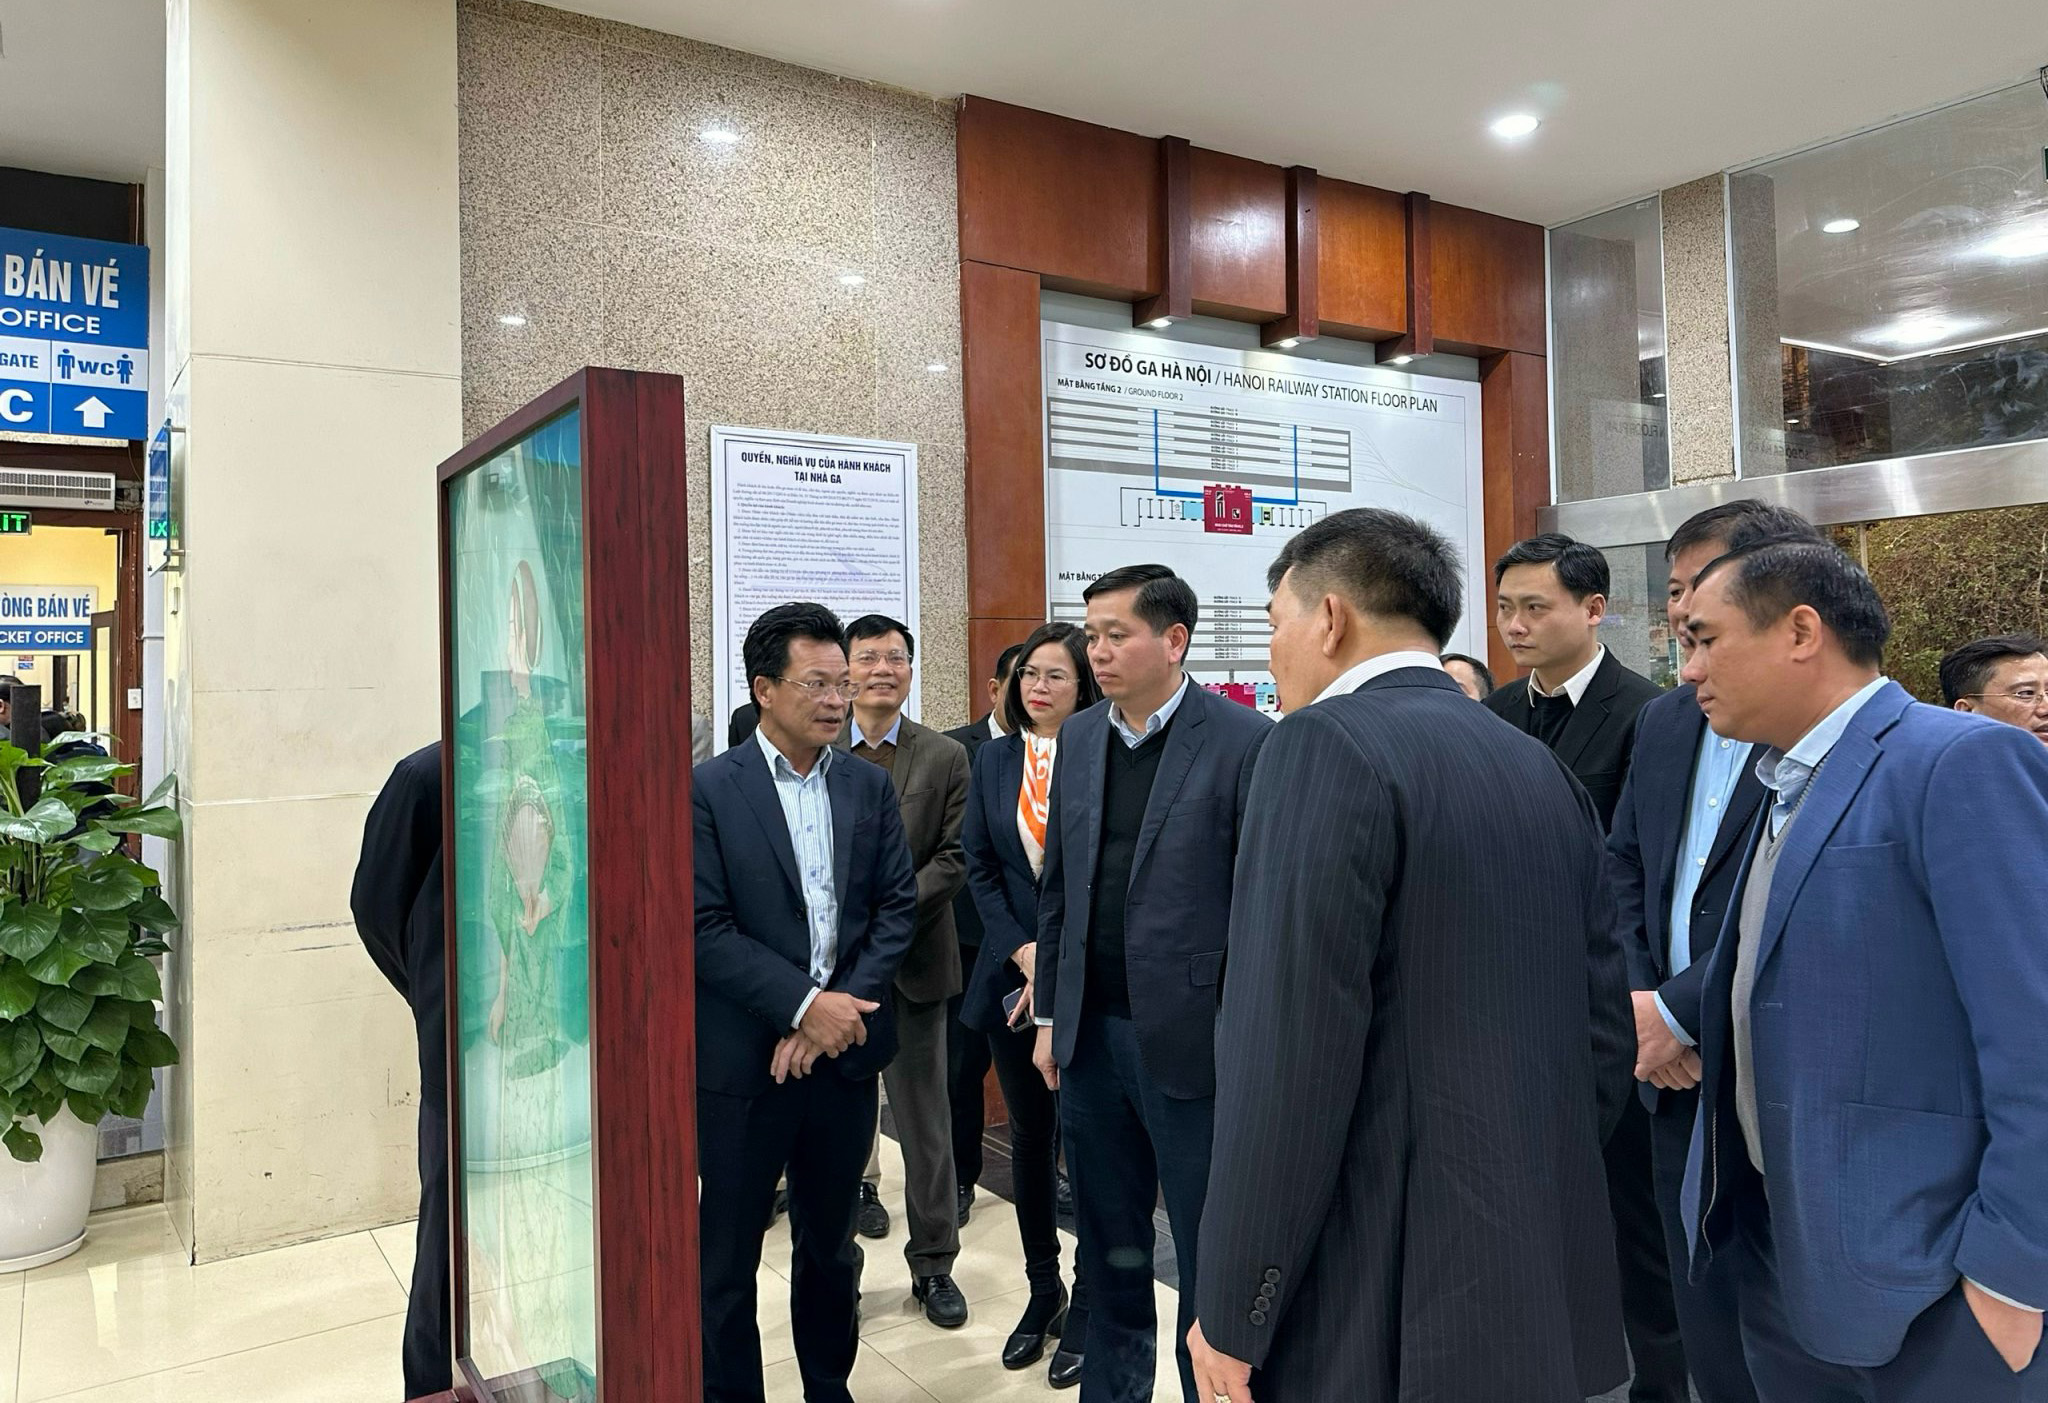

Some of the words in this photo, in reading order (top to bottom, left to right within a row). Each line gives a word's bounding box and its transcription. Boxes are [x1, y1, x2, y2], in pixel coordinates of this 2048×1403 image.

[4, 248, 72, 304] BÁN
[82, 258, 120, 309] VÉ
[0, 307, 101, 335] OFFICE
[0, 353, 39, 369] GATE
[78, 360, 115, 376] WC
[1085, 353, 1107, 370] SƠ
[1109, 354, 1133, 374] ĐỒ
[1137, 360, 1158, 377] GA
[1162, 361, 1182, 380] HÀ
[1186, 365, 1212, 387] NỘI
[1224, 370, 1265, 391] HANOI
[1268, 380, 1319, 398] RAILWAY
[1321, 385, 1368, 404] STATION
[1371, 391, 1408, 410] FLOOR
[1409, 396, 1438, 413] PLAN
[1117, 386, 1122, 394] 2
[1128, 387, 1157, 398] GROUND
[1158, 390, 1179, 401] FLOOR
[1179, 393, 1184, 401] 2
[0, 388, 34, 423] C
[776, 454, 803, 467] NGHĨA
[805, 457, 816, 470] VỤ
[818, 456, 836, 469] CỦA
[838, 458, 861, 471] HÀNH
[863, 460, 891, 473] KHÁCH
[794, 471, 808, 484] TẠI
[810, 471, 828, 483] NHÀ
[830, 474, 842, 484] GA
[1, 592, 33, 618] ÒNG
[37, 593, 68, 618] BÁN
[73, 593, 91, 618] VÉ
[34, 630, 84, 644] OFFICE
